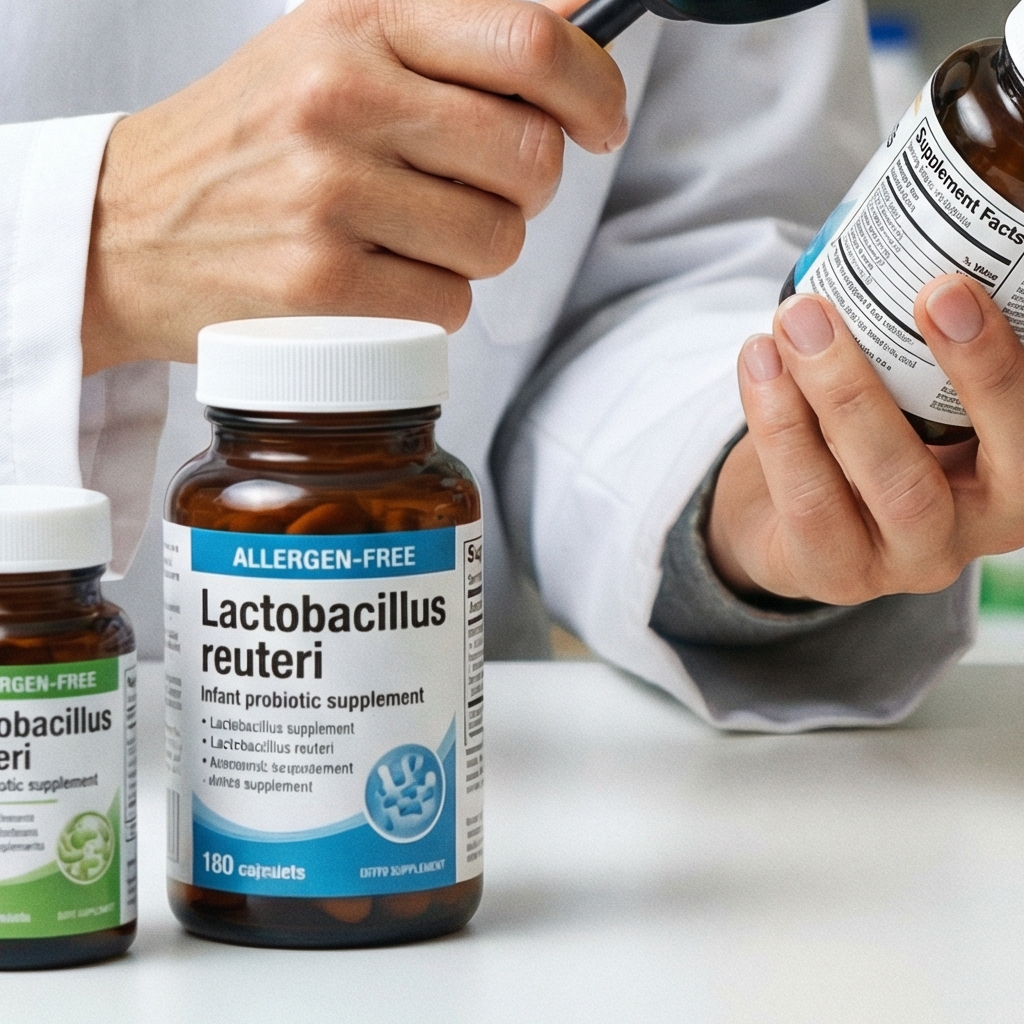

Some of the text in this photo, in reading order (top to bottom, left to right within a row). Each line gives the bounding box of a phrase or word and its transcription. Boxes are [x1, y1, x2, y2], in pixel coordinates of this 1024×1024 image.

[916, 127, 980, 214] Supplement
[233, 546, 416, 569] ALLERGEN-FREE
[202, 588, 446, 633] Lactobacillus
[202, 641, 322, 679] reuteri
[201, 685, 241, 706] Infant
[245, 689, 321, 710] probiotic
[327, 687, 424, 712] supplement
[287, 721, 355, 738] supplement
[202, 852, 234, 875] 180
